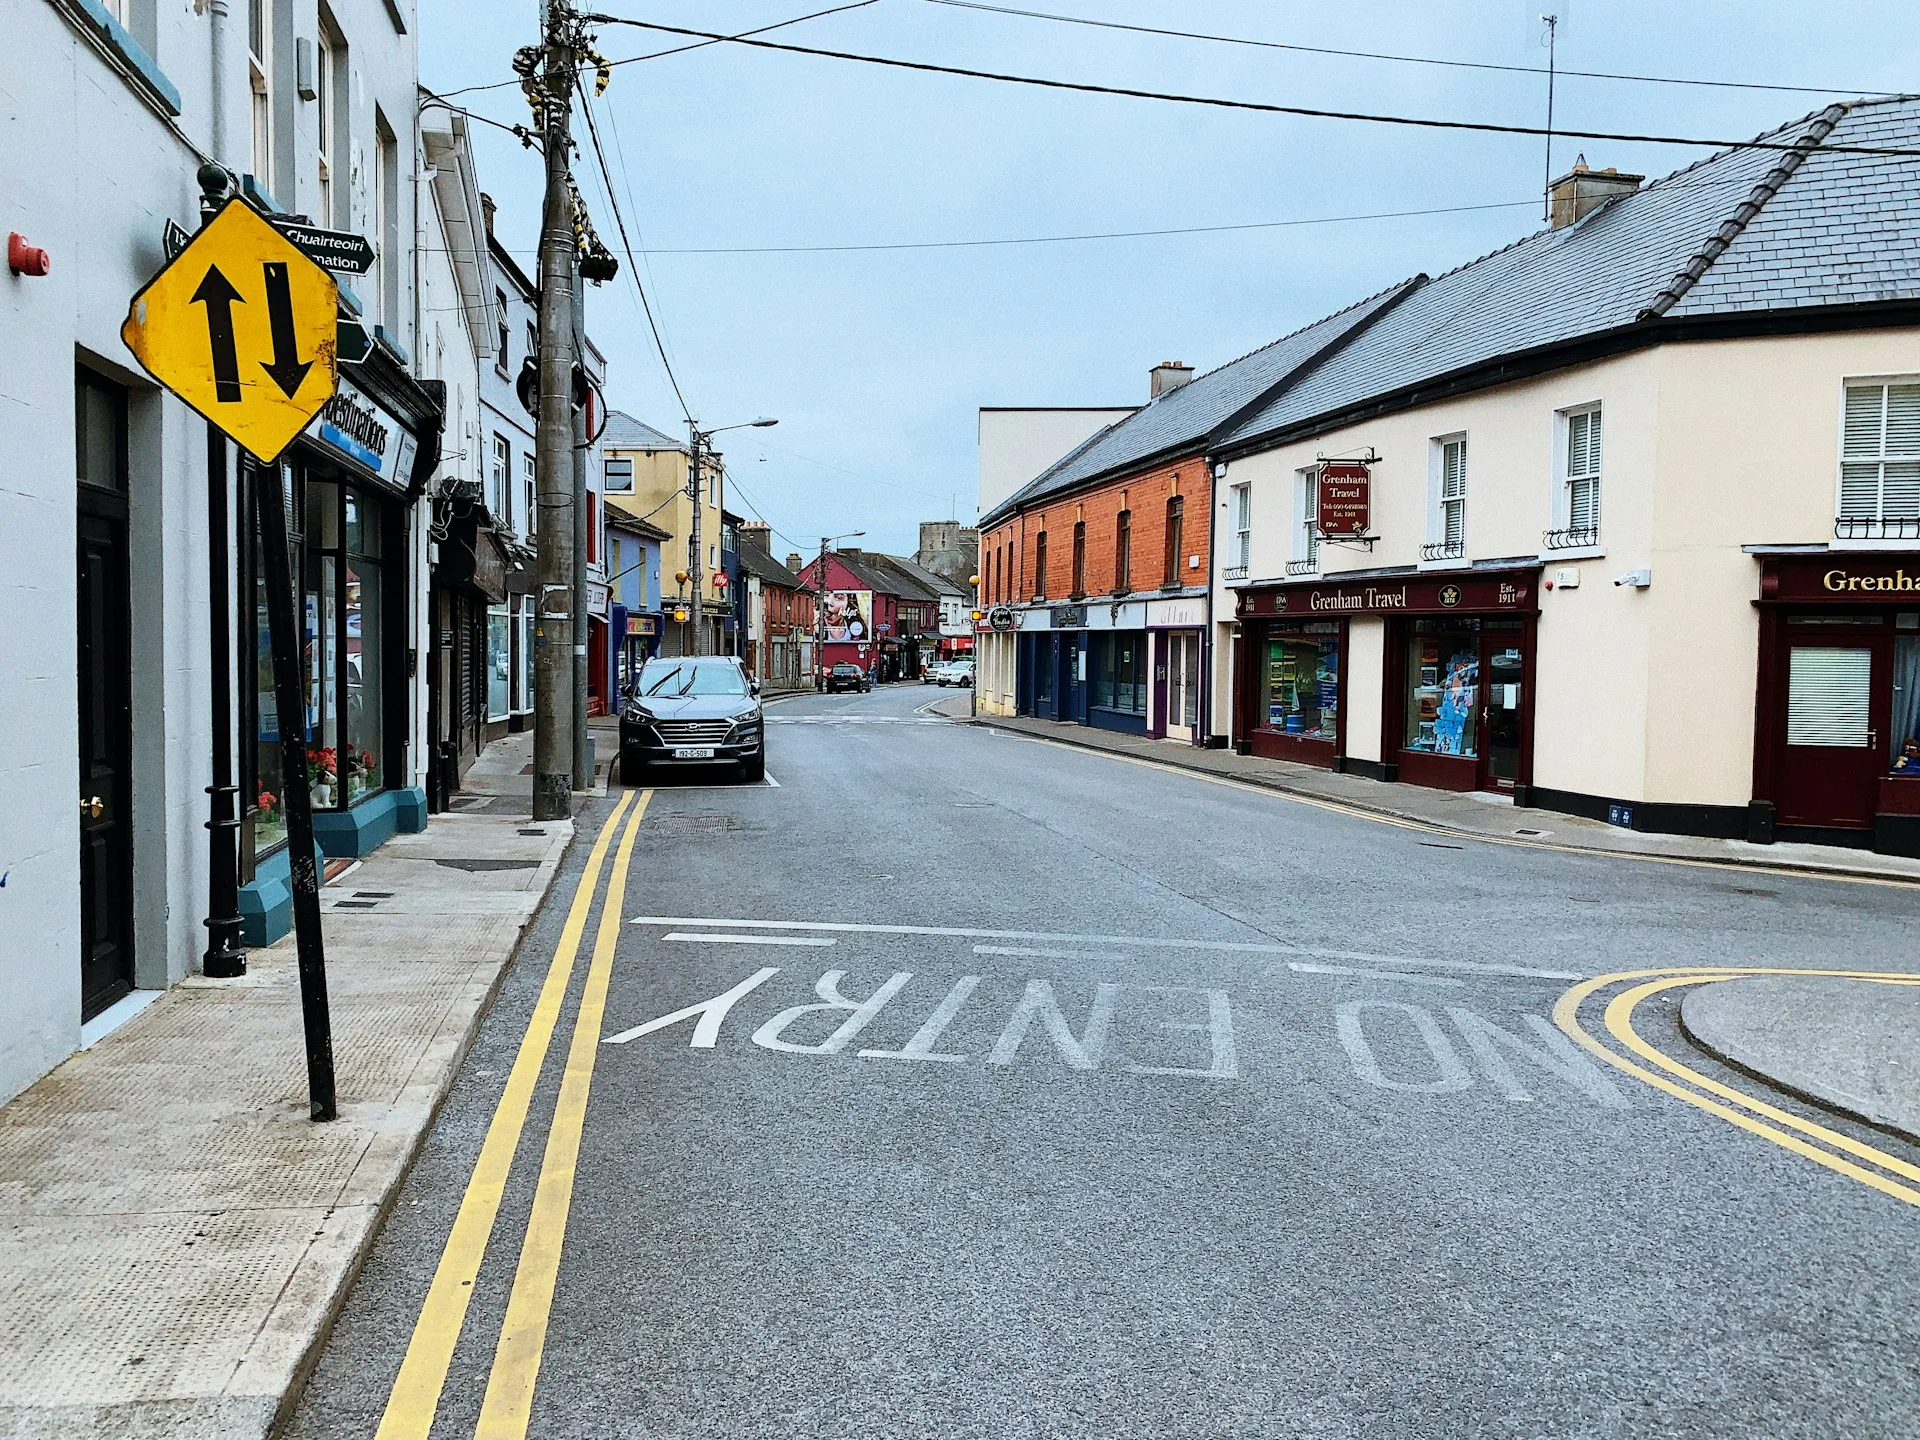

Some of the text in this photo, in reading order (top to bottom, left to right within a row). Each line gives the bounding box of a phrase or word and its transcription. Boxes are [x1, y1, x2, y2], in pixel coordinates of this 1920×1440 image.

[1322, 473, 1367, 484] Grenham
[1329, 487, 1360, 498] Travel
[714, 574, 728, 587] illy
[1500, 583, 1515, 593] Est.
[1310, 585, 1407, 611] Grenham Travel
[1498, 593, 1516, 603] 1911
[837, 607, 859, 619] helps
[993, 609, 1009, 617] Spice
[599, 966, 1634, 1112] NO ENTRY
